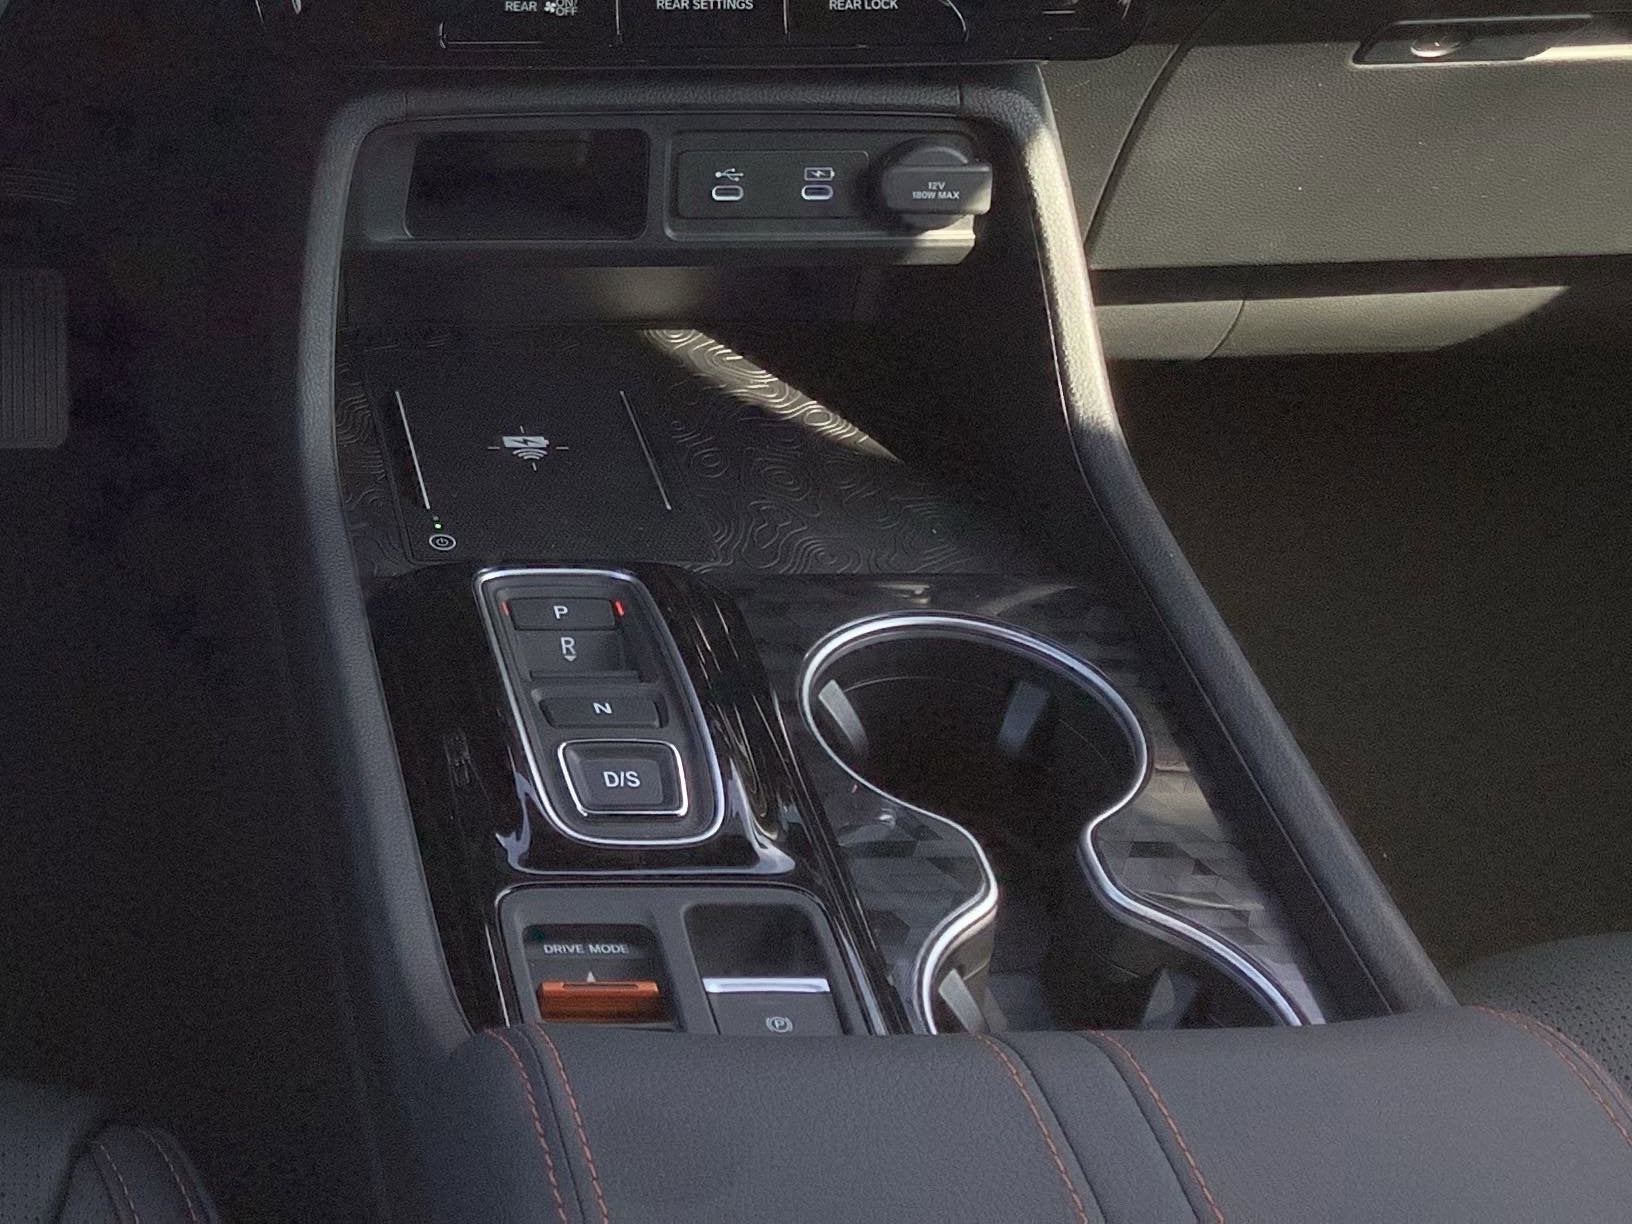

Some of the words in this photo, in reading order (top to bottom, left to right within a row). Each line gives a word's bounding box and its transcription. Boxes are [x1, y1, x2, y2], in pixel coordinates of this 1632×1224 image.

[505, 0, 537, 12] REAR
[828, 0, 862, 10] REAR
[555, 6, 578, 16] OFF
[927, 181, 946, 191] 12V
[911, 190, 936, 200] 180W
[937, 190, 960, 200] MAX
[553, 604, 568, 619] P
[560, 636, 576, 655] R
[593, 701, 612, 714] N
[603, 771, 641, 788] D/S
[543, 944, 585, 955] DRIVE
[588, 944, 630, 955] MODE
